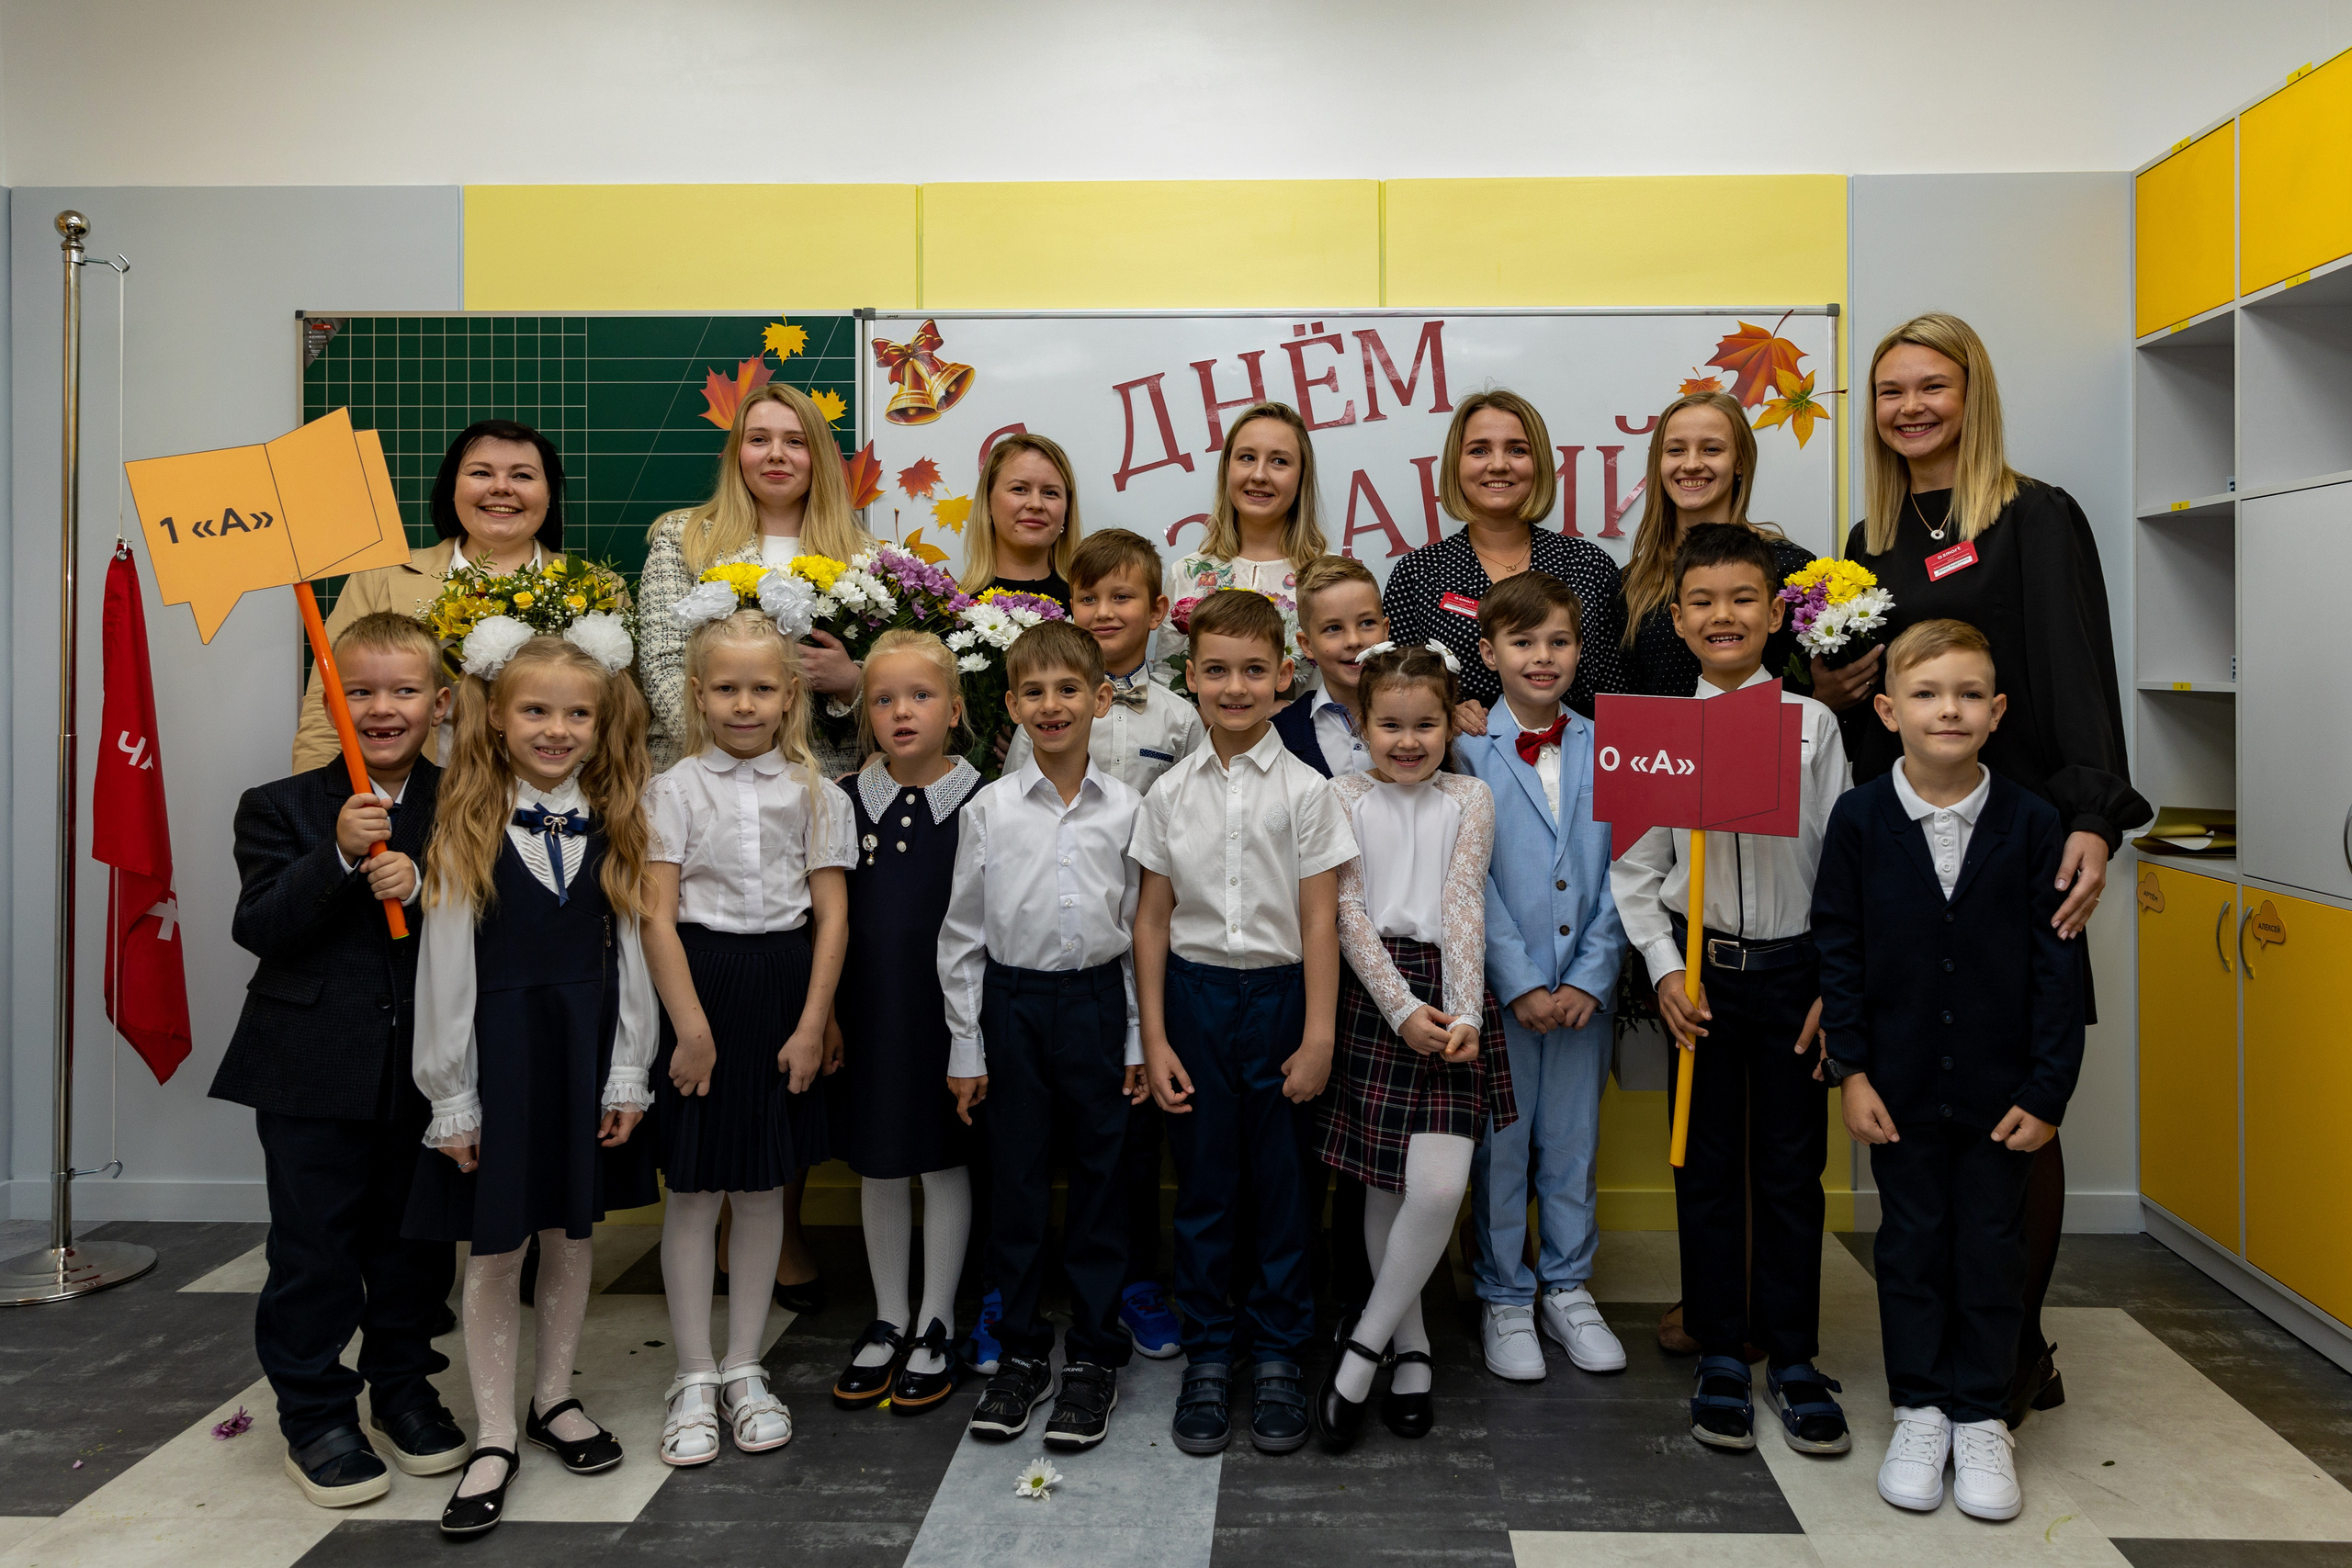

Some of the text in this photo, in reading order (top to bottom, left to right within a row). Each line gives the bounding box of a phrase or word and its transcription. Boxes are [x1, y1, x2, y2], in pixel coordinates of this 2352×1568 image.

[1113, 322, 1453, 492] ДНЁМ
[159, 516, 179, 545] 1
[2143, 890, 2158, 903] АРТЁМ
[2257, 922, 2281, 933] АЛЕКСЕЙ
[1011, 1357, 1032, 1369] VIKING
